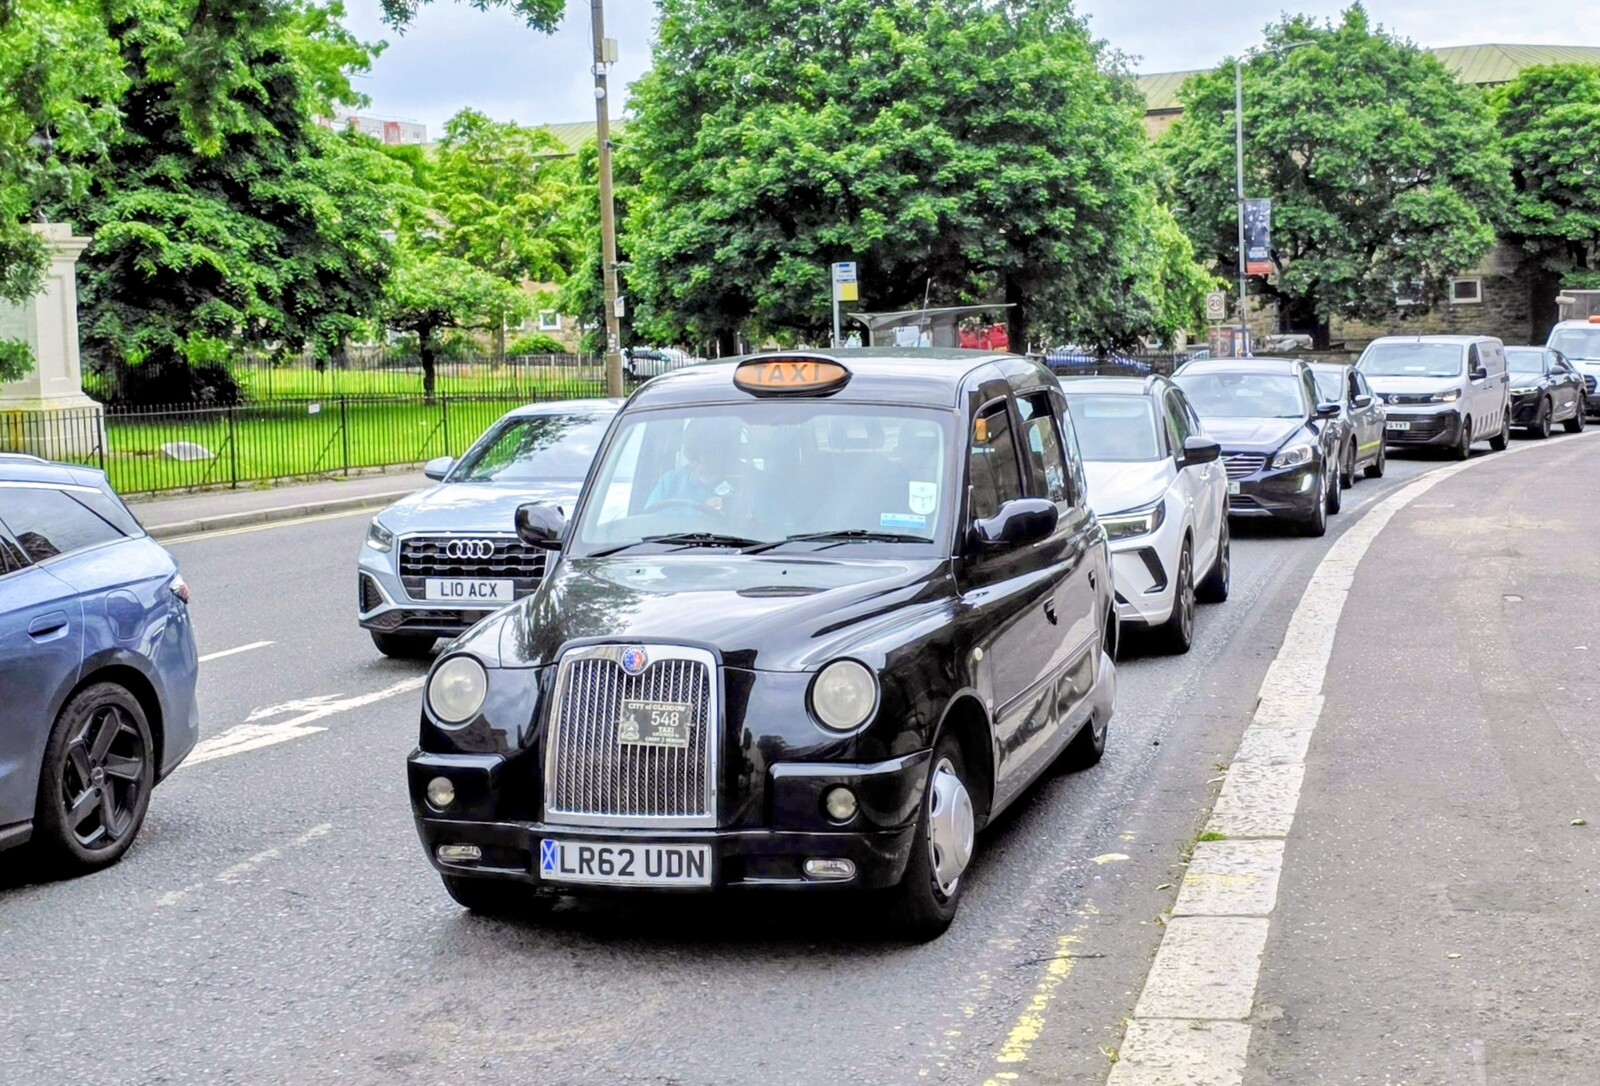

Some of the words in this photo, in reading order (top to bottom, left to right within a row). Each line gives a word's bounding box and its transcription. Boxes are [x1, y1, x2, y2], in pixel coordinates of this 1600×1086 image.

[1210, 298, 1221, 307] 20
[754, 363, 821, 383] TAXI
[468, 582, 498, 598] ACX
[628, 702, 645, 710] CITY
[652, 703, 686, 712] GLASGOW
[650, 710, 680, 727] 548
[559, 845, 635, 877] LR62
[645, 849, 705, 878] UDN
